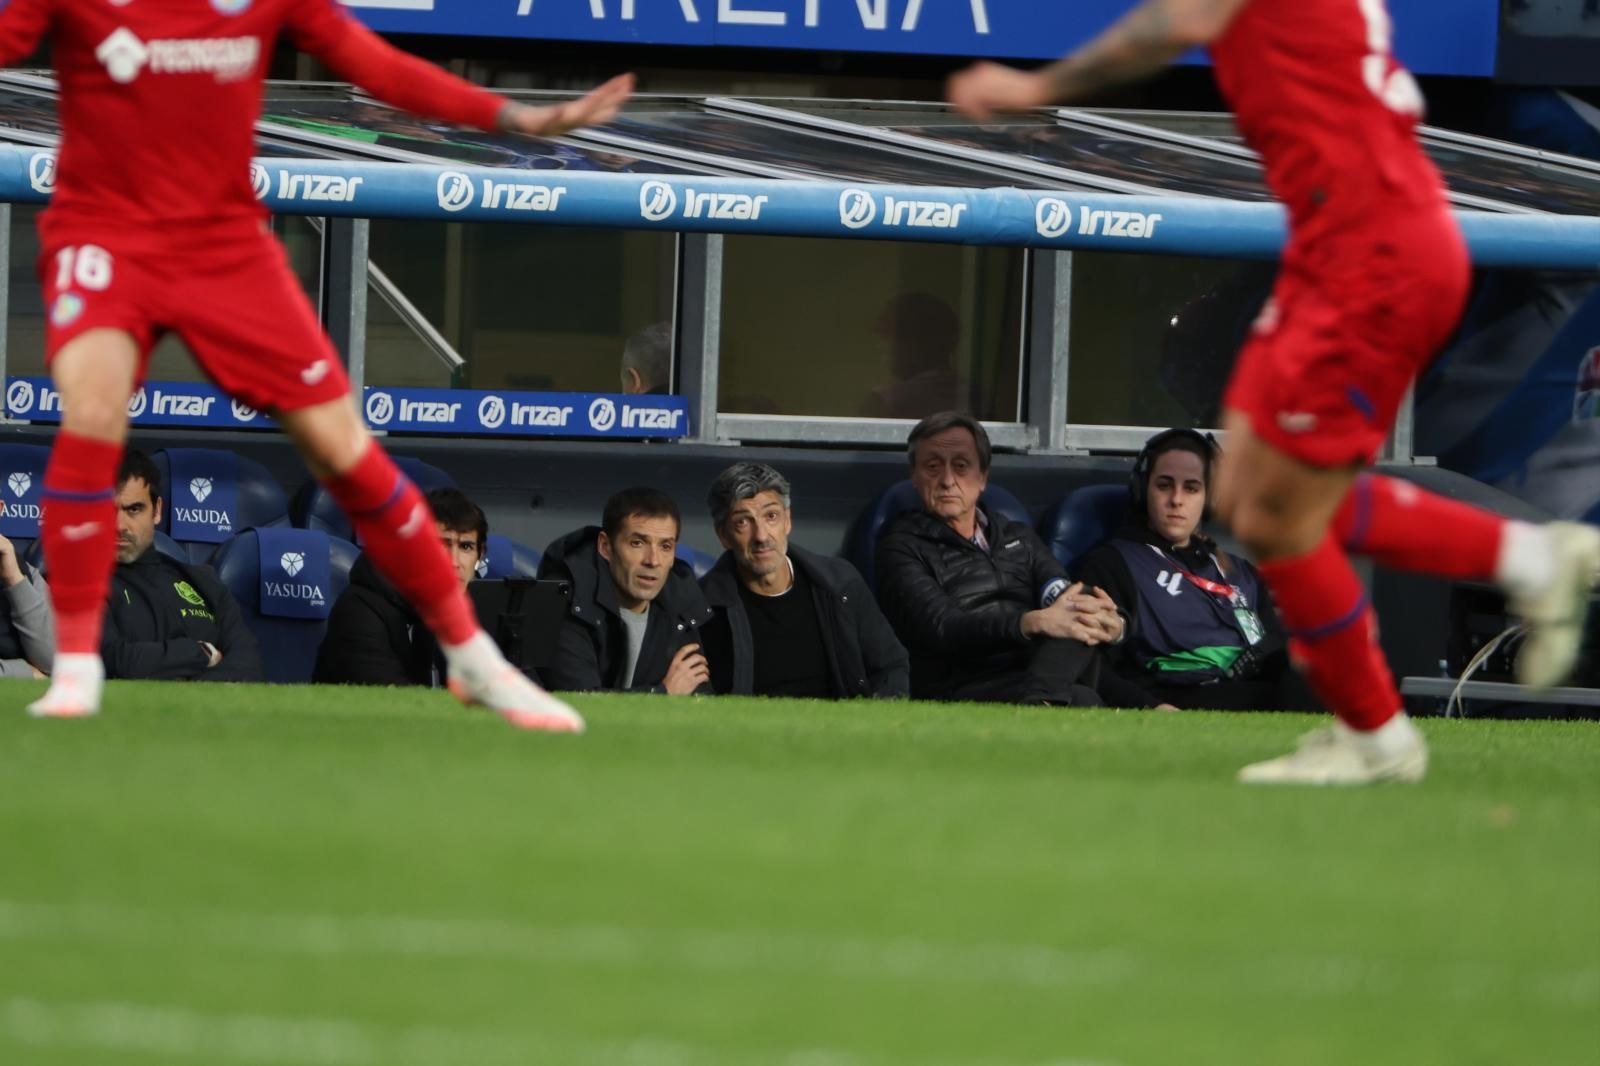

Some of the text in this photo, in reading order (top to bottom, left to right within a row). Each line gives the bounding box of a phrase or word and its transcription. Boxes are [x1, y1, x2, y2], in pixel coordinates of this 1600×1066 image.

[278, 170, 363, 201] Irizar
[480, 179, 567, 213] Irizar
[684, 187, 769, 221] Irizar
[883, 196, 967, 229] Irizar
[1078, 206, 1163, 239] Irizar
[56, 244, 113, 291] 16
[152, 390, 216, 417] Irizar
[399, 398, 462, 423] Irizar
[510, 402, 573, 426] Irizar
[621, 404, 684, 429] Irizar
[0, 504, 45, 519] ASUD
[175, 508, 232, 525] YASUDA
[265, 582, 324, 599] YASUDA
